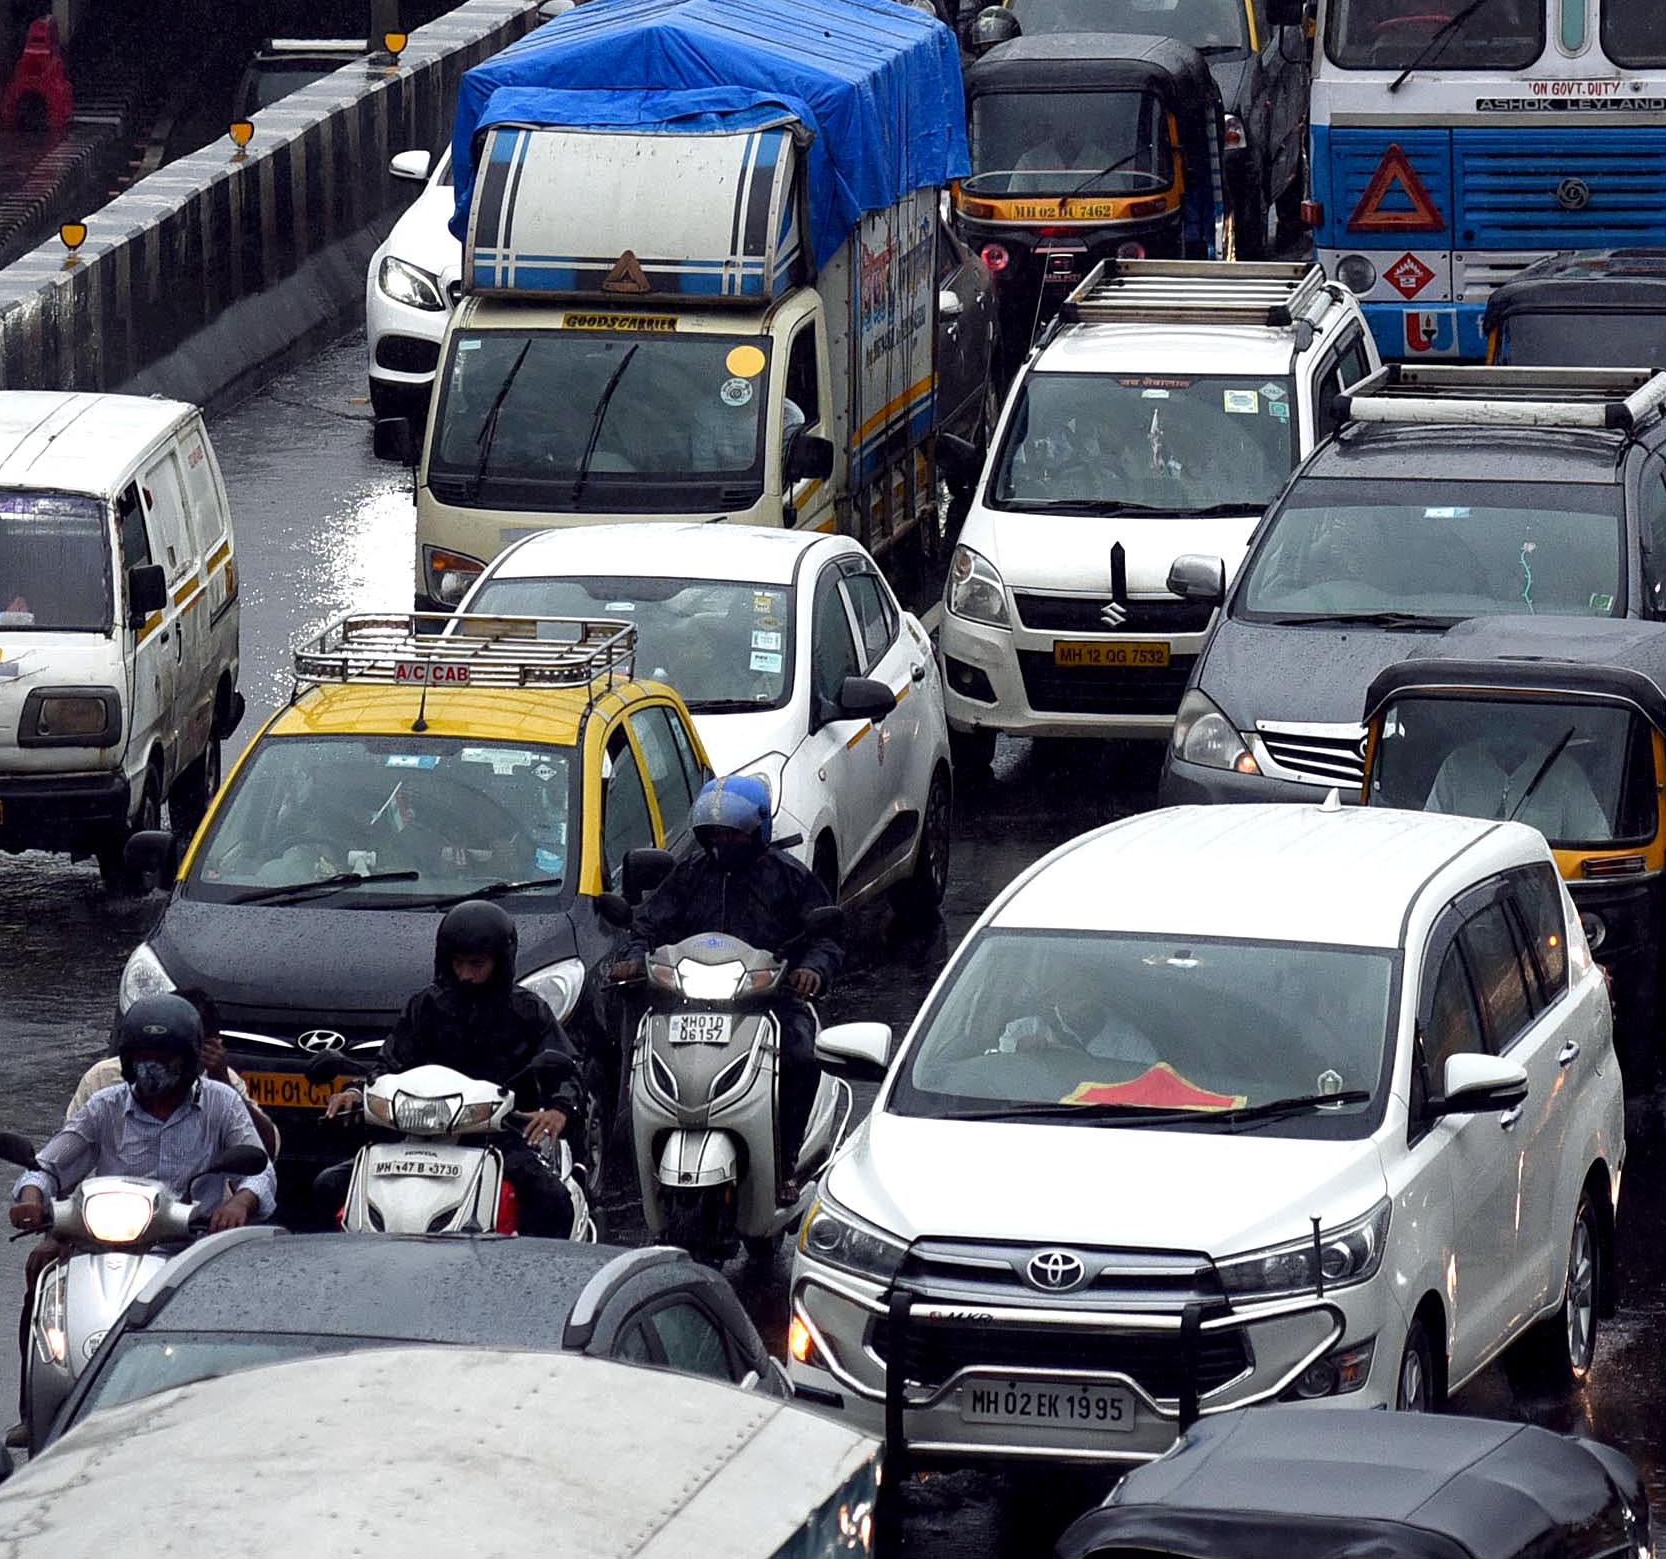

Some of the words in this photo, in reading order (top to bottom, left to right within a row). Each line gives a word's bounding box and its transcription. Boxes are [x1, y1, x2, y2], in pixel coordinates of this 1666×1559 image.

[1479, 98, 1552, 111] ASHOK
[1567, 97, 1666, 111] LEYLAND
[1014, 207, 1036, 218] MH
[1038, 207, 1055, 219] 02
[1079, 206, 1112, 218] 7462
[1060, 647, 1082, 661] MH
[1087, 647, 1101, 661] 12
[1105, 647, 1127, 662] QG
[1132, 647, 1165, 663] 7532
[396, 666, 425, 681] A/C
[432, 667, 469, 681] CAB
[375, 1162, 392, 1174] MH
[971, 1392, 1001, 1416] MH
[1005, 1392, 1032, 1418] 02
[1036, 1395, 1061, 1418] EK
[1067, 1396, 1124, 1422] 1995
